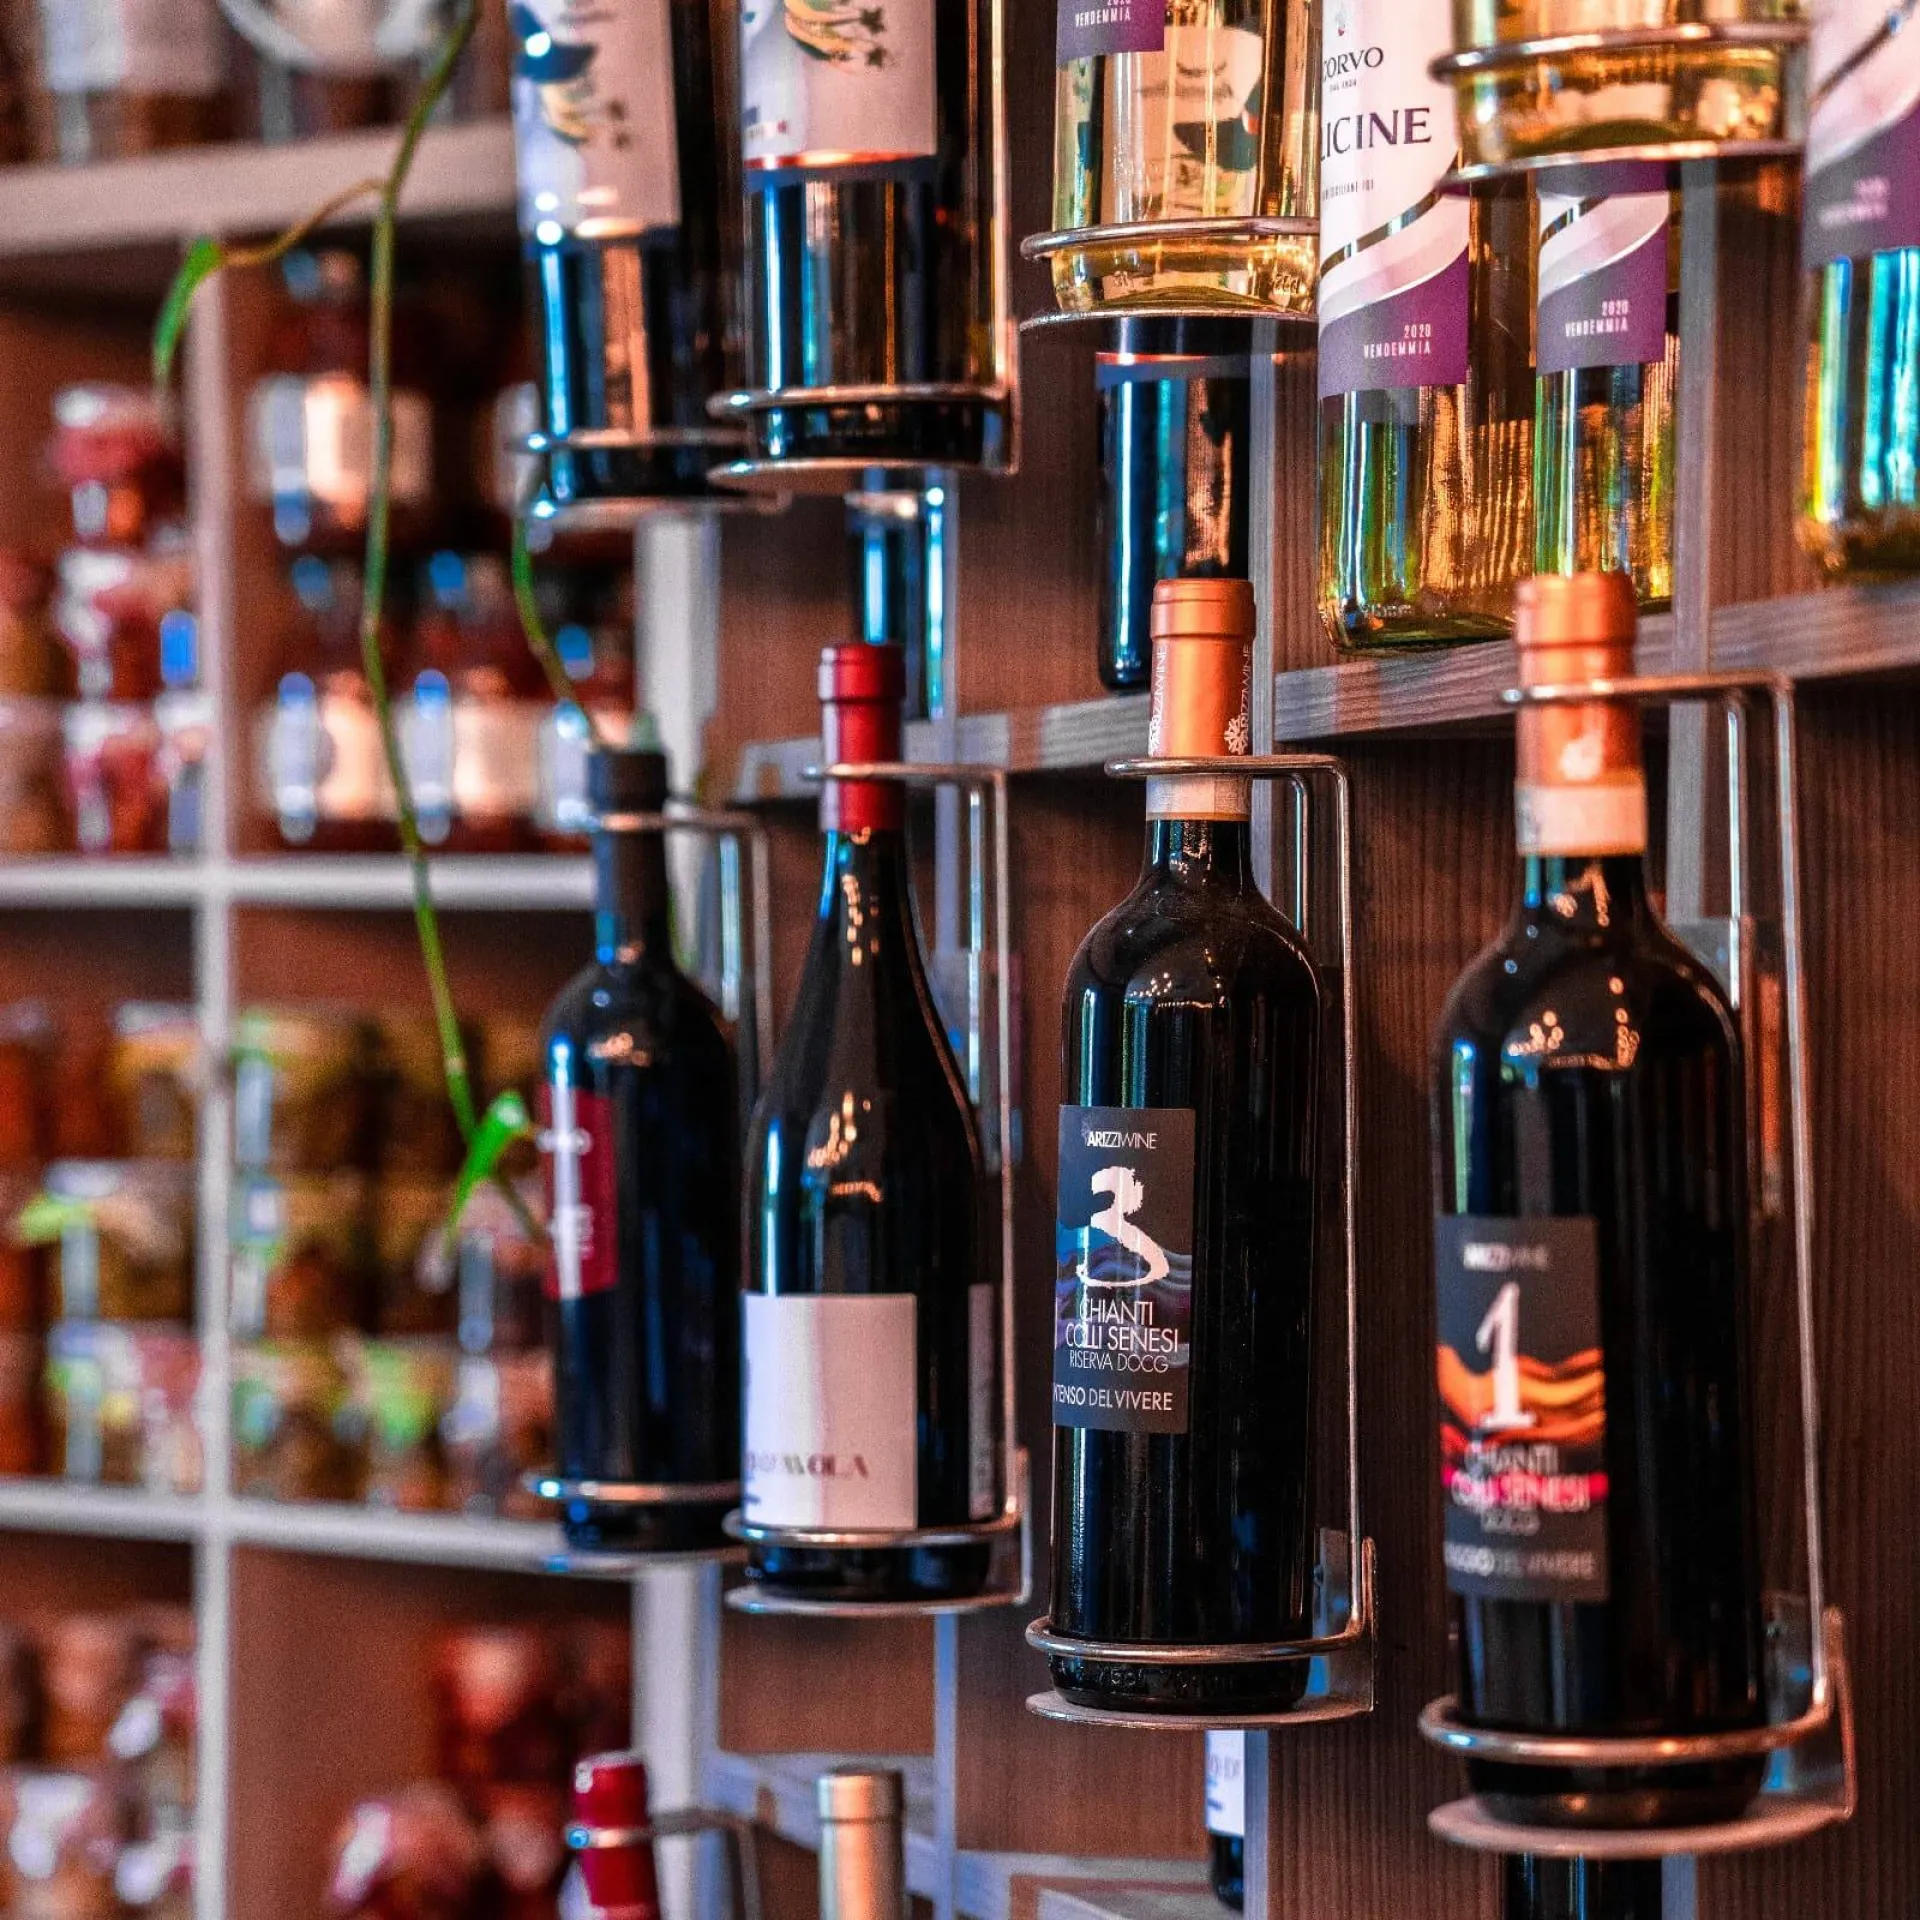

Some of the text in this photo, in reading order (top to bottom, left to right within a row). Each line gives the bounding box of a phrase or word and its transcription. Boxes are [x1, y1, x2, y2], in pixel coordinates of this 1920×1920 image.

[1075, 7, 1131, 27] VENDEMMIA
[1321, 107, 1432, 161] ICINE
[1602, 299, 1629, 317] 2020
[1403, 323, 1431, 338] 2020
[1565, 316, 1628, 337] VENDEMMIA
[1363, 340, 1431, 359] VENDEMMIA
[1080, 1298, 1153, 1326] CHIANTI
[1065, 1322, 1178, 1353] COLLI SENESI
[1069, 1349, 1169, 1373] RISERVA DOCG
[1089, 1387, 1113, 1408] DEL
[1115, 1390, 1173, 1411] VIVERE
